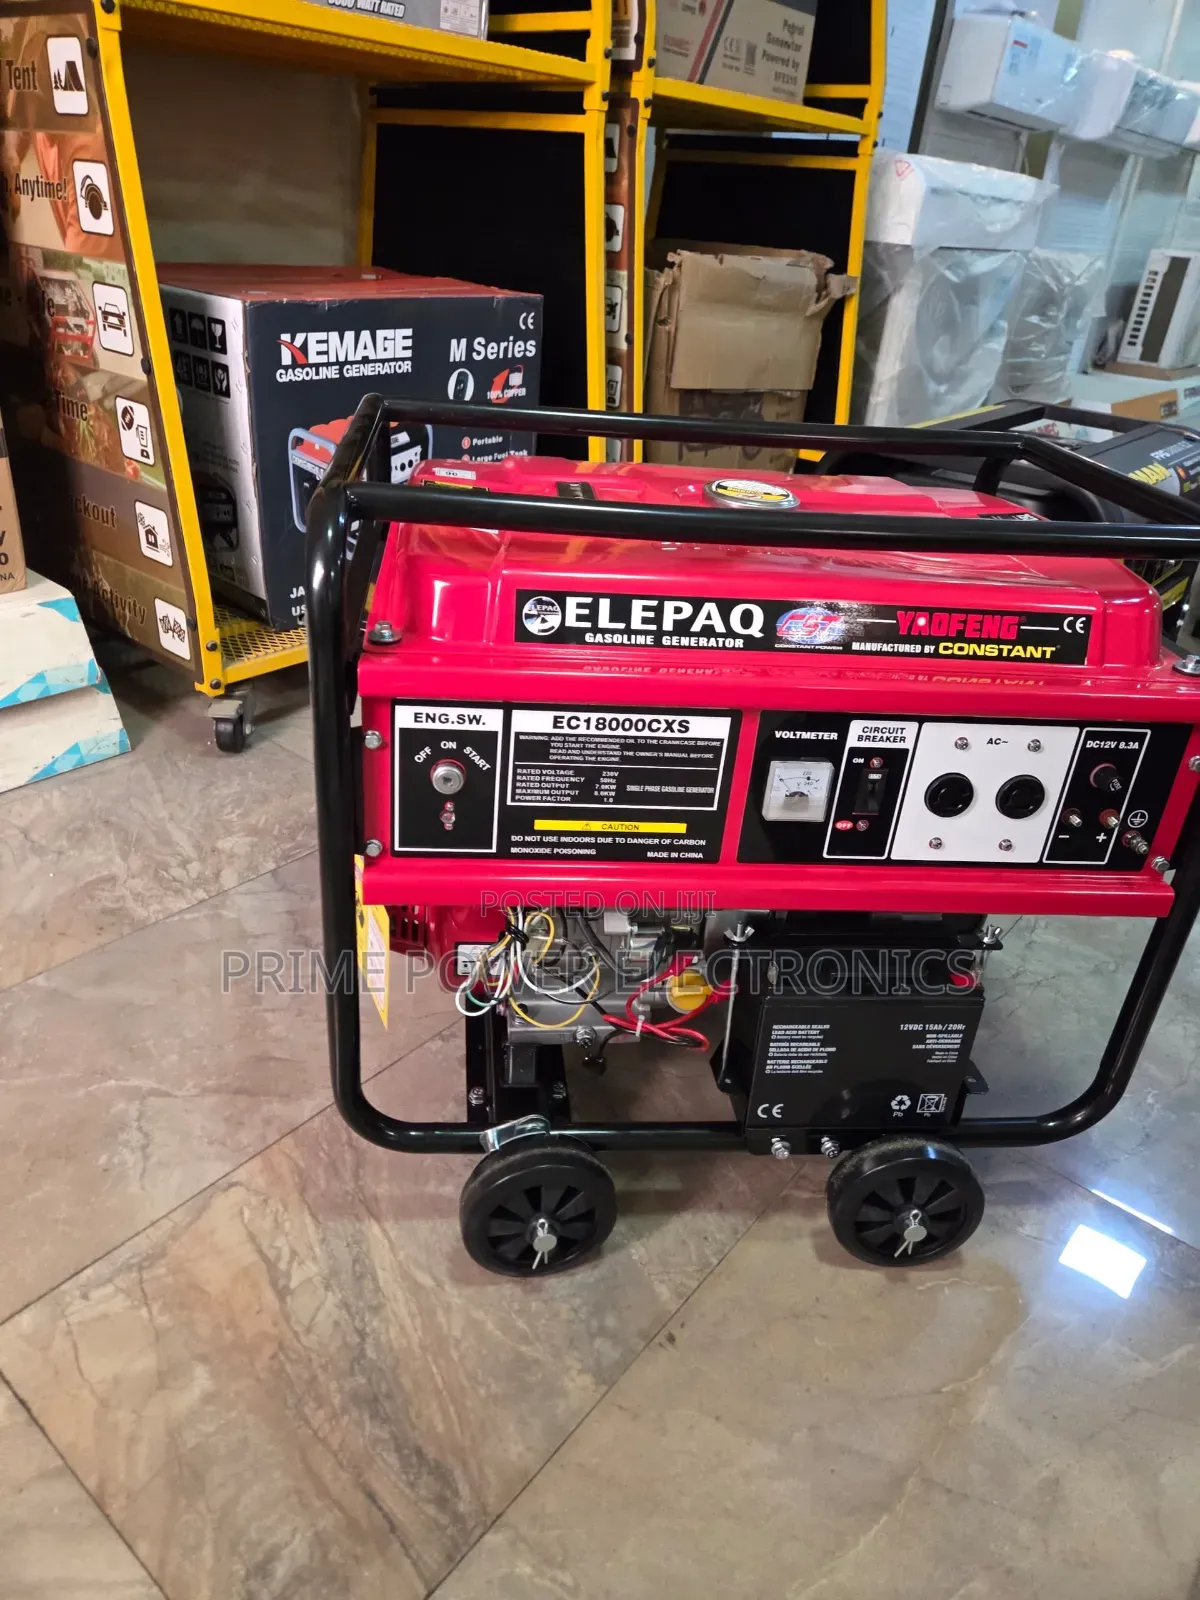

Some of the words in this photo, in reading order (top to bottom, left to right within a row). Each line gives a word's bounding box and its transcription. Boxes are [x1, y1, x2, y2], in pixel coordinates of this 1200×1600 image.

[380, 3, 405, 18] RATED
[6, 60, 37, 90] Tent
[15, 173, 67, 201] Anytime!
[276, 328, 413, 366] KEMAGE
[449, 338, 467, 362] M
[472, 336, 536, 361] Series
[276, 366, 340, 382] GASOLINE
[343, 361, 412, 377] GENERATOR
[504, 387, 526, 398] COPPER
[472, 435, 503, 446] Portable
[565, 597, 764, 638] ELEPAQ
[897, 611, 1020, 639] YAOFENG
[585, 633, 654, 644] GASOLINE
[662, 636, 744, 648] GENERATOR
[852, 642, 921, 653] MANUFACTURED
[924, 645, 935, 654] BY
[939, 642, 1055, 659] CONSTANT
[414, 712, 486, 725] ENG.SW.
[552, 715, 690, 734] EC18000CXS
[775, 730, 838, 740] VOLTMETER
[857, 734, 906, 743] BREAKER
[862, 726, 906, 735] CIRCUIT
[440, 741, 457, 749] ON
[1086, 740, 1117, 749] DC12V
[1118, 741, 1139, 749] 8.3A
[414, 746, 432, 763] OFF
[463, 746, 491, 771] START
